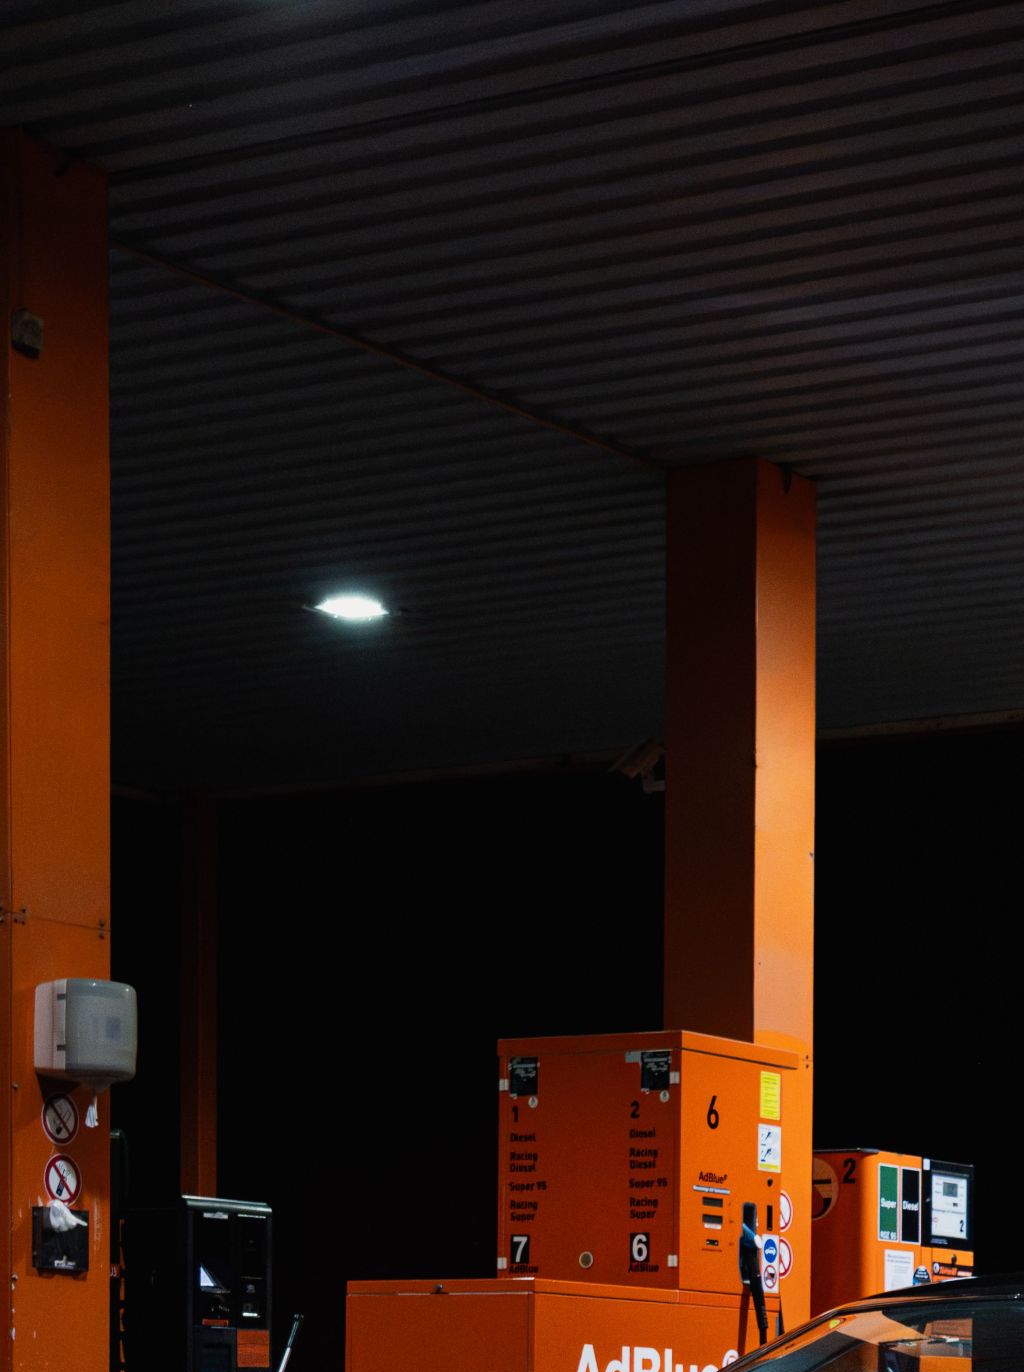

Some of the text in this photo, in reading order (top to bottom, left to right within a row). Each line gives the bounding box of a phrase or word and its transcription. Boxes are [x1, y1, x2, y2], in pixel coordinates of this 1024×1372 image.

[511, 1105, 519, 1123] 1
[630, 1101, 640, 1119] 2
[707, 1095, 719, 1130] 6
[509, 1133, 536, 1142] Diesel
[629, 1128, 656, 1139] Diesel
[509, 1152, 538, 1162] Racing
[629, 1148, 658, 1159] Racing
[509, 1163, 536, 1173] Diesel
[629, 1159, 656, 1169] Diesel
[843, 1159, 857, 1184] 2
[508, 1181, 535, 1192] Super
[628, 1178, 668, 1190] Super 95
[509, 1200, 538, 1211] Racing
[629, 1197, 658, 1208] Racing
[880, 1197, 897, 1209] Super
[902, 1200, 919, 1212] Diesel
[509, 1211, 535, 1222] Super
[629, 1209, 656, 1220] Super
[960, 1219, 964, 1233] 2
[512, 1236, 528, 1262] 7
[632, 1234, 648, 1262] 6
[628, 1263, 659, 1272] AdBlue
